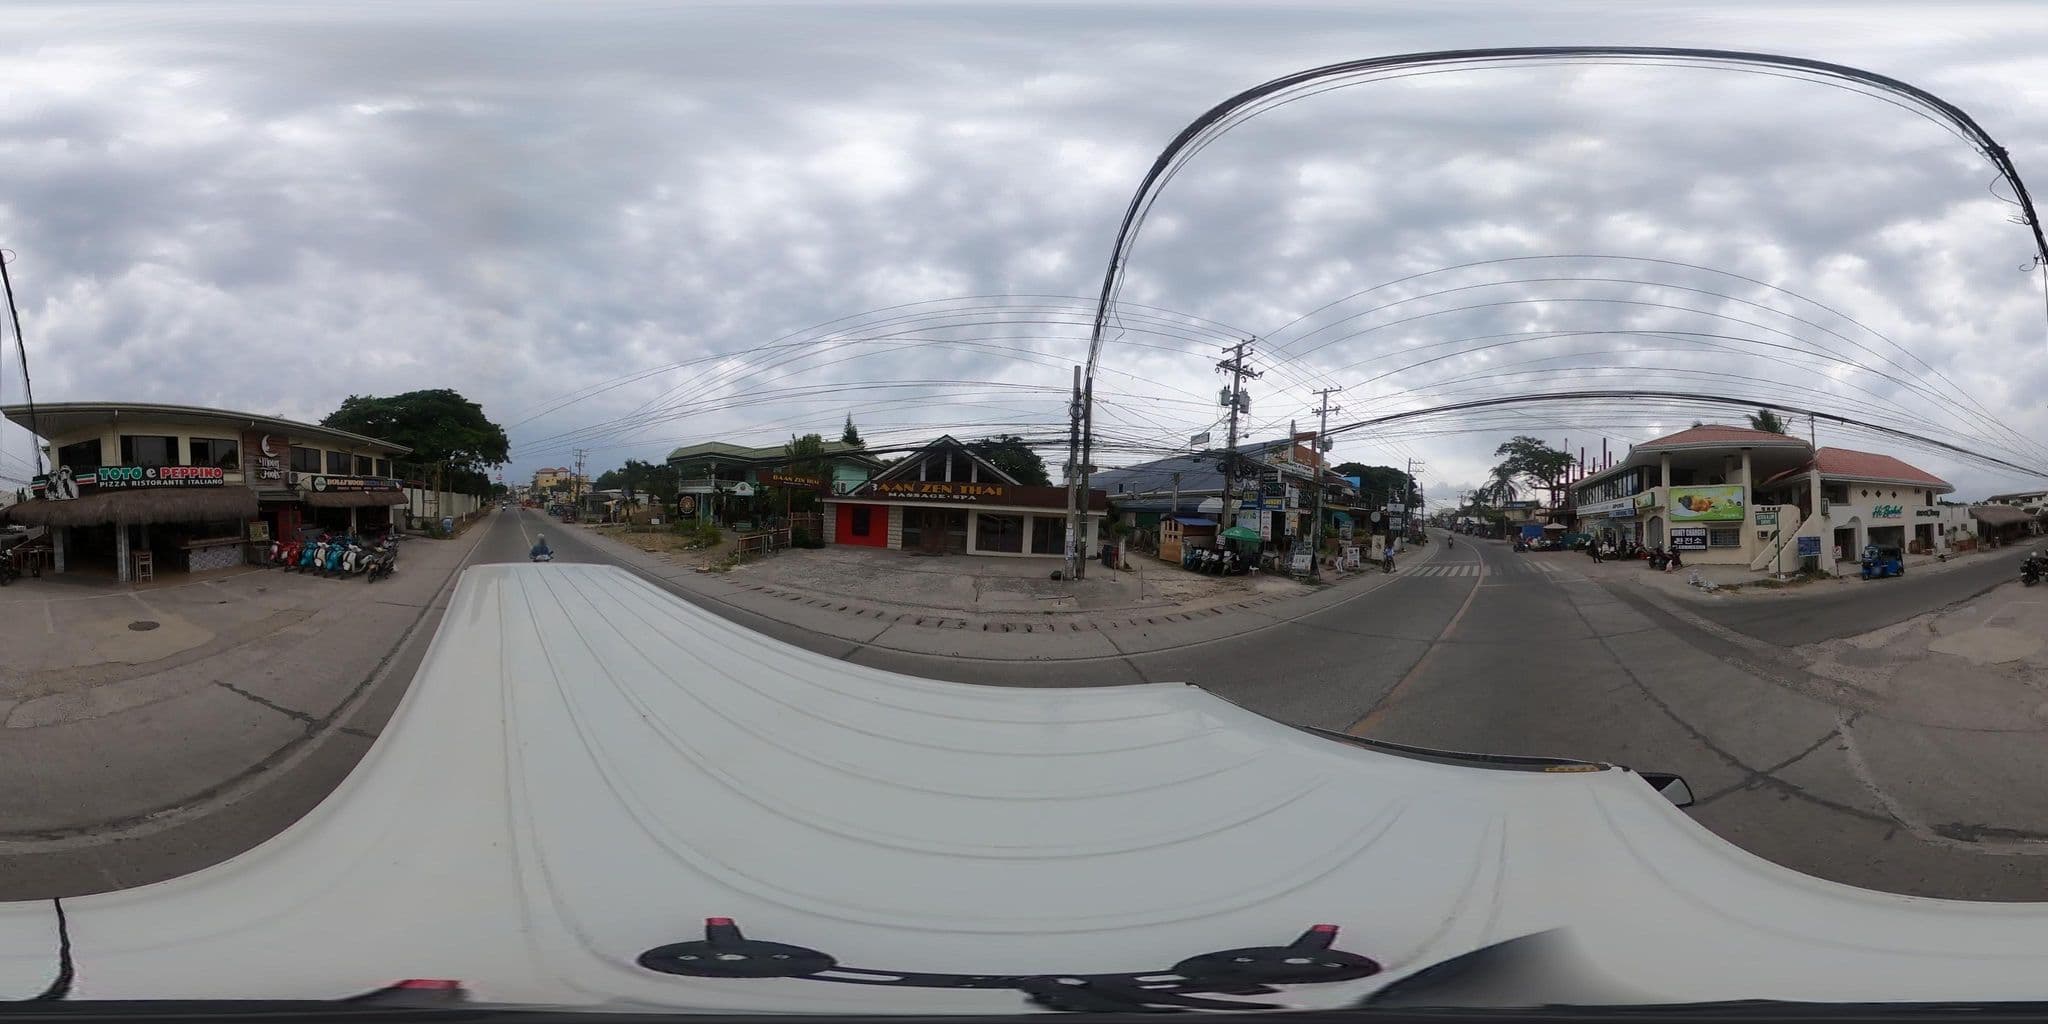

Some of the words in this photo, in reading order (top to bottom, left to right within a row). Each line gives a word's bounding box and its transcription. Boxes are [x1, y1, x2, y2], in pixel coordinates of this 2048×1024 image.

[146, 468, 156, 478] e
[160, 467, 223, 479] PEPPINO
[131, 479, 184, 487] RISTORANTE
[921, 484, 953, 493] ZEN
[960, 485, 1003, 496] THAI
